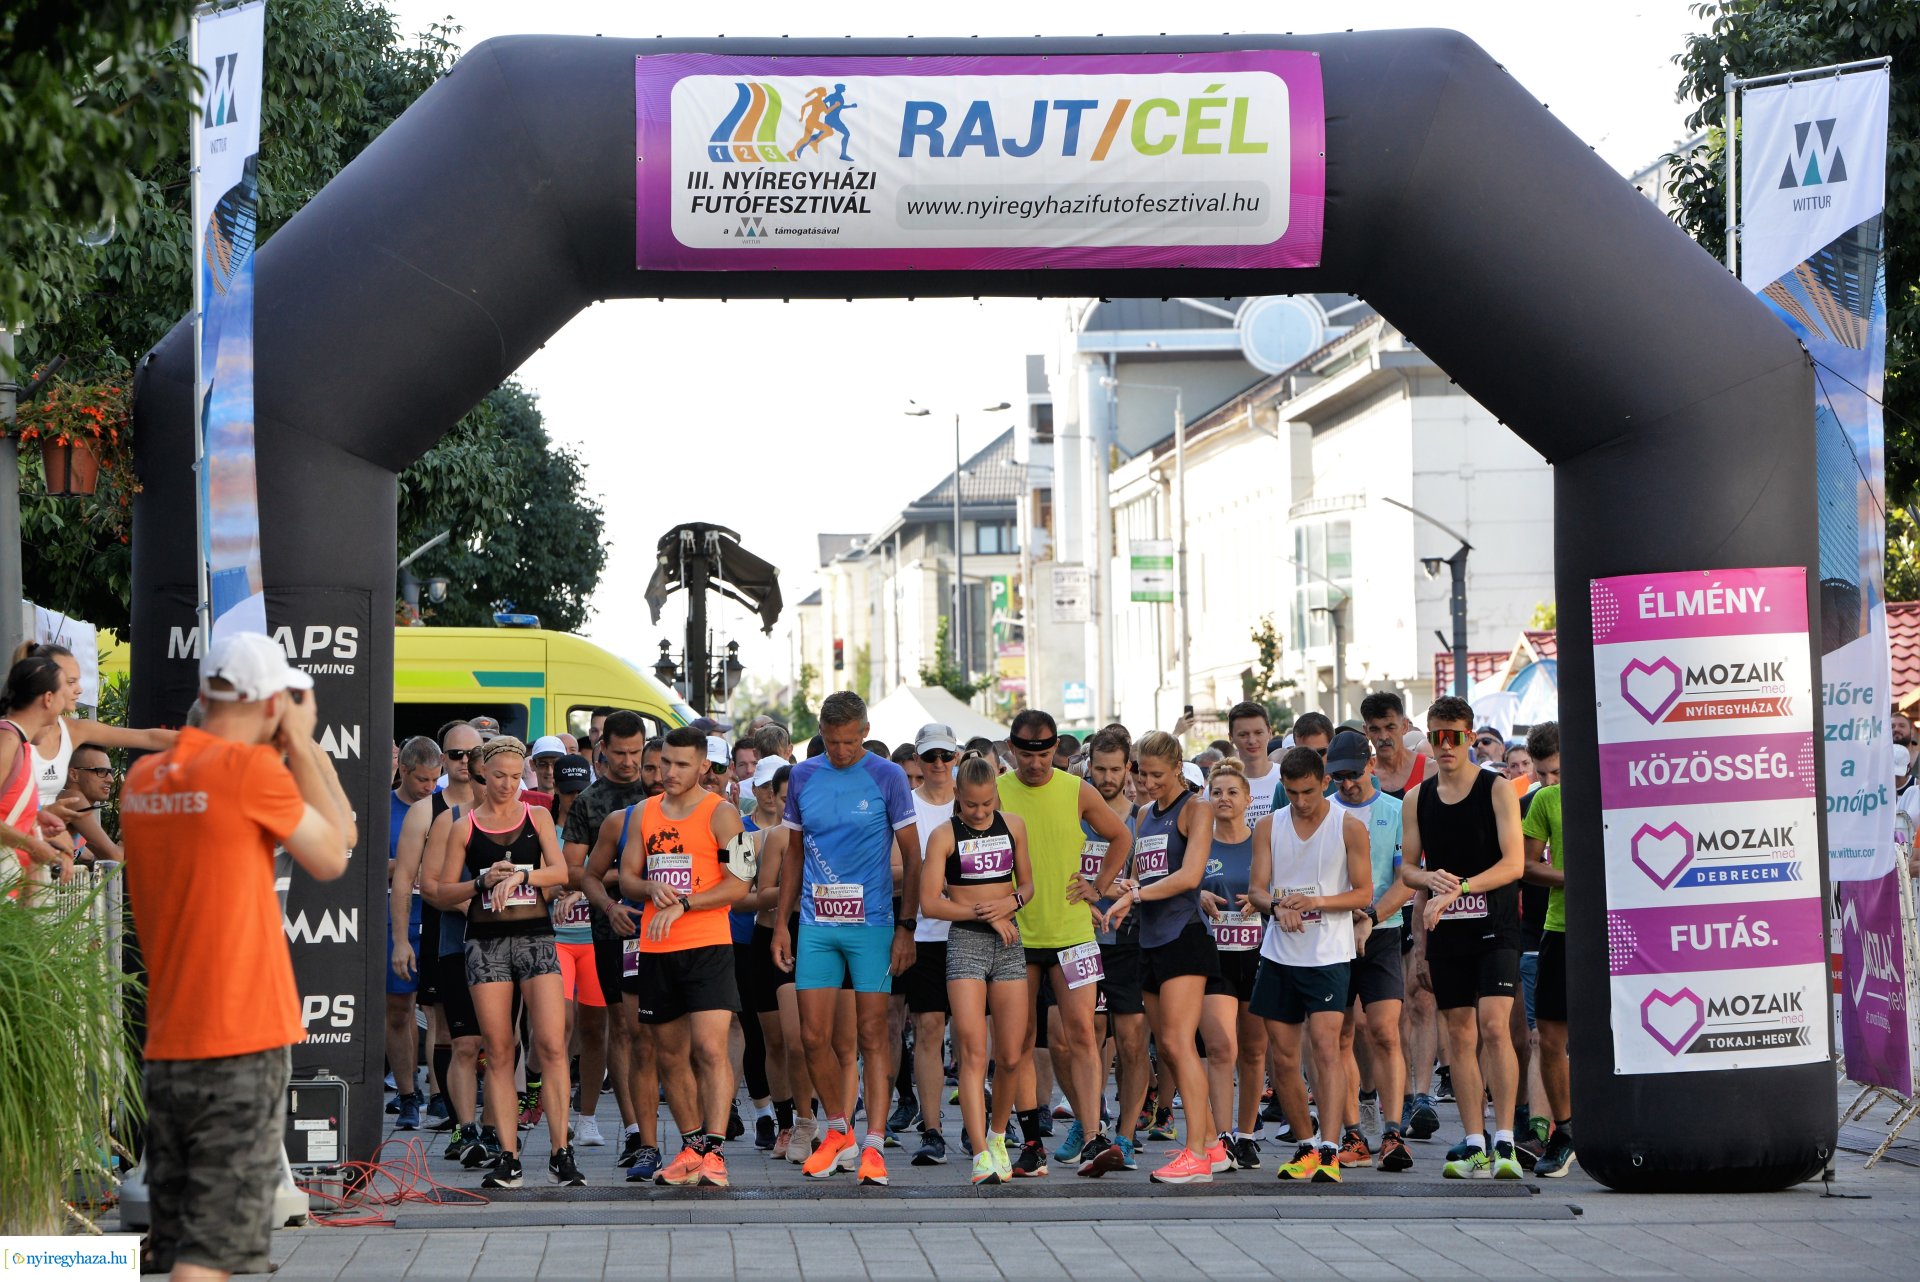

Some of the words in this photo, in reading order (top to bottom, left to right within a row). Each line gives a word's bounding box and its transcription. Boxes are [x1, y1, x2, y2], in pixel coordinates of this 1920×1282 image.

[898, 83, 1269, 162] RAJT/CÉL
[714, 148, 723, 160] 1
[739, 148, 752, 160] 2
[765, 147, 777, 159] 3
[687, 171, 714, 190] III.
[722, 167, 877, 190] NYÍREGYHÁZI
[691, 190, 872, 214] FUTÓFESZTIVÁL
[906, 192, 1260, 219] www.nyiregyhazifutofesztival.hu
[1792, 195, 1832, 212] WITTUR
[774, 226, 840, 236] támogatásával
[1638, 581, 1771, 619] ÉLMÉNY.
[168, 626, 359, 659] MAPS
[1685, 661, 1784, 686] MOZAIK
[1761, 682, 1786, 694] med
[1685, 700, 1773, 717] NYÍREGYHÁZA
[1628, 746, 1795, 787] KÖZÖSSÉG.
[1840, 759, 1855, 777] a
[1696, 826, 1794, 852] MOZAIK
[806, 833, 841, 884] SZALADÓ
[974, 852, 1002, 871] 557
[1136, 851, 1166, 872] 10167
[1771, 847, 1796, 859] med
[1697, 868, 1780, 882] DEBRECEN
[815, 900, 862, 916] 10027
[1212, 927, 1258, 943] 10181
[1670, 915, 1779, 952] FUTÁS.
[1075, 957, 1099, 977] 538
[1706, 991, 1803, 1018] MOZAIK
[1781, 1012, 1805, 1024] med
[299, 1032, 351, 1045] IMING
[1707, 1033, 1792, 1049] TOKAJI-HEGY
